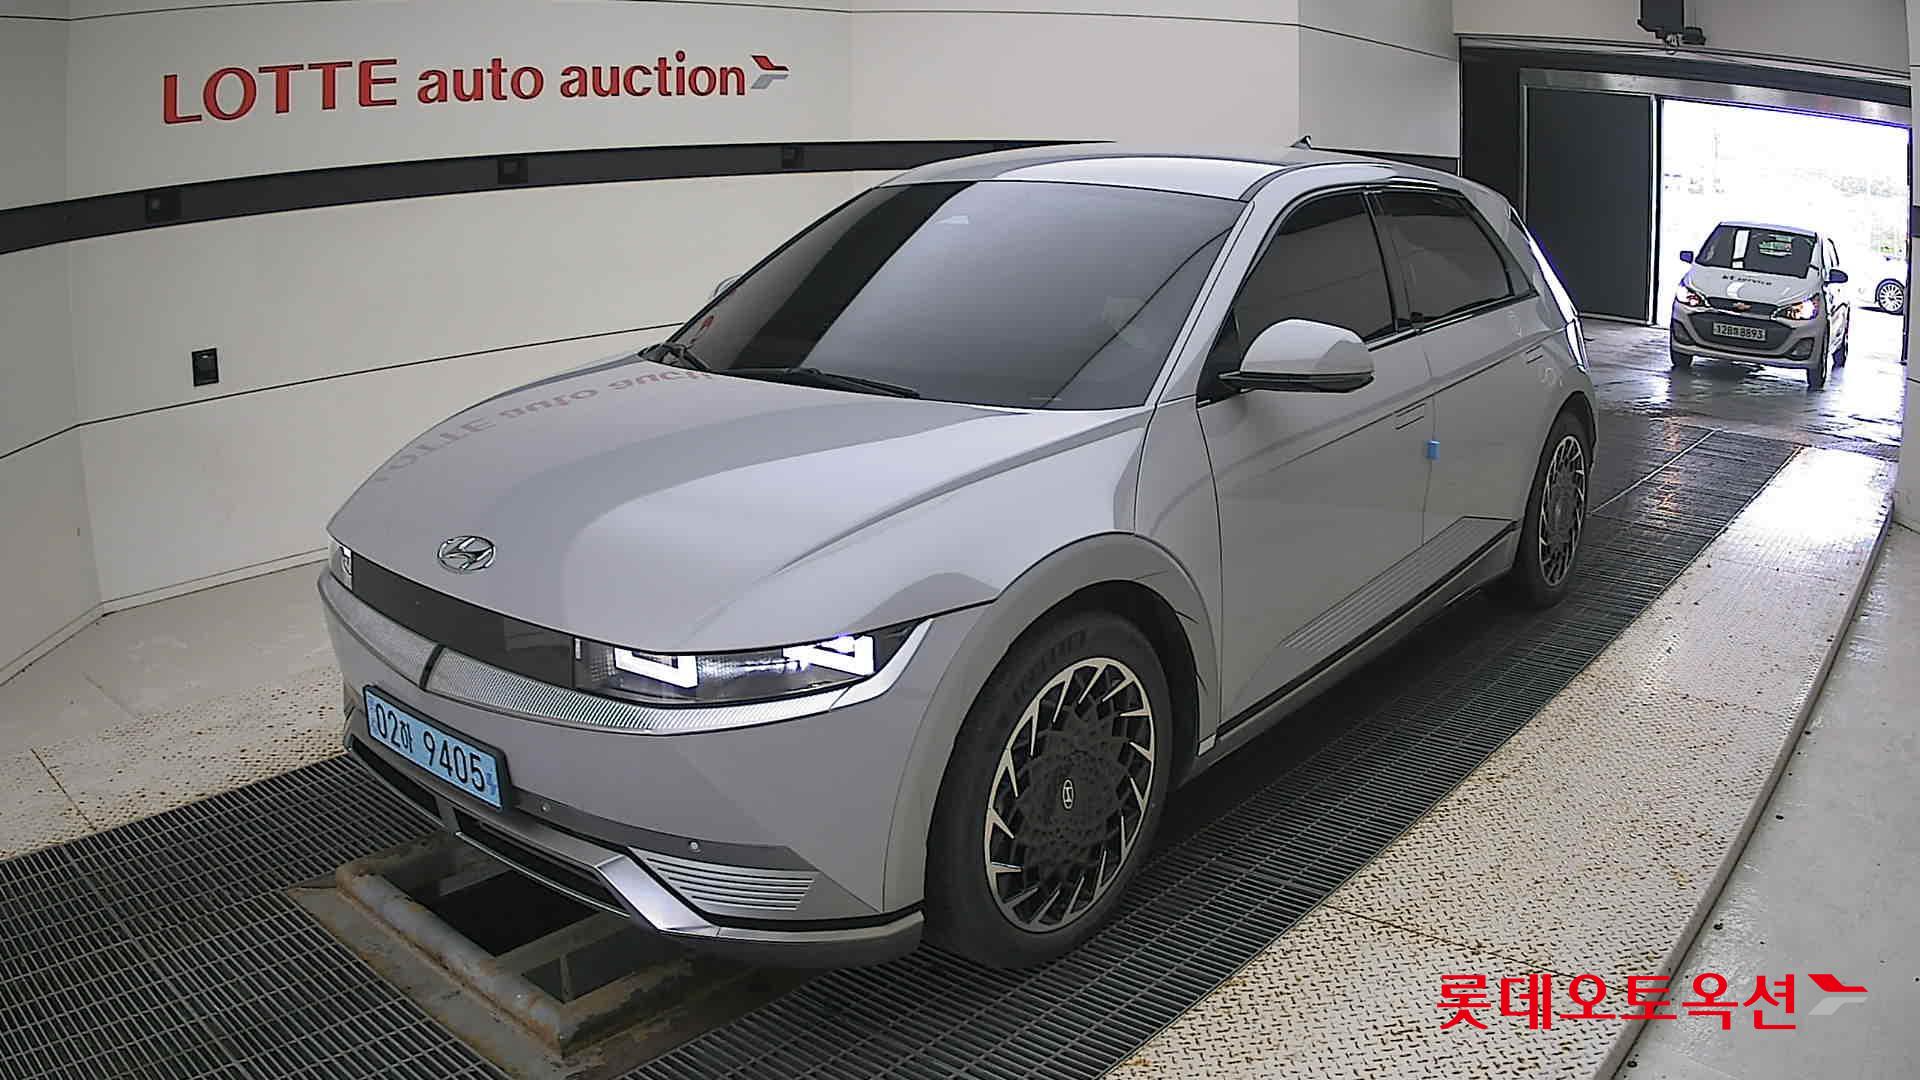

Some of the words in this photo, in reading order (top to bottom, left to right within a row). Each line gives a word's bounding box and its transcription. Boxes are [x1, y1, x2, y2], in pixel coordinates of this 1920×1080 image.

[163, 58, 398, 124] LOTTE
[417, 57, 544, 104] auto
[559, 50, 746, 99] auction
[423, 730, 485, 792] 9405
